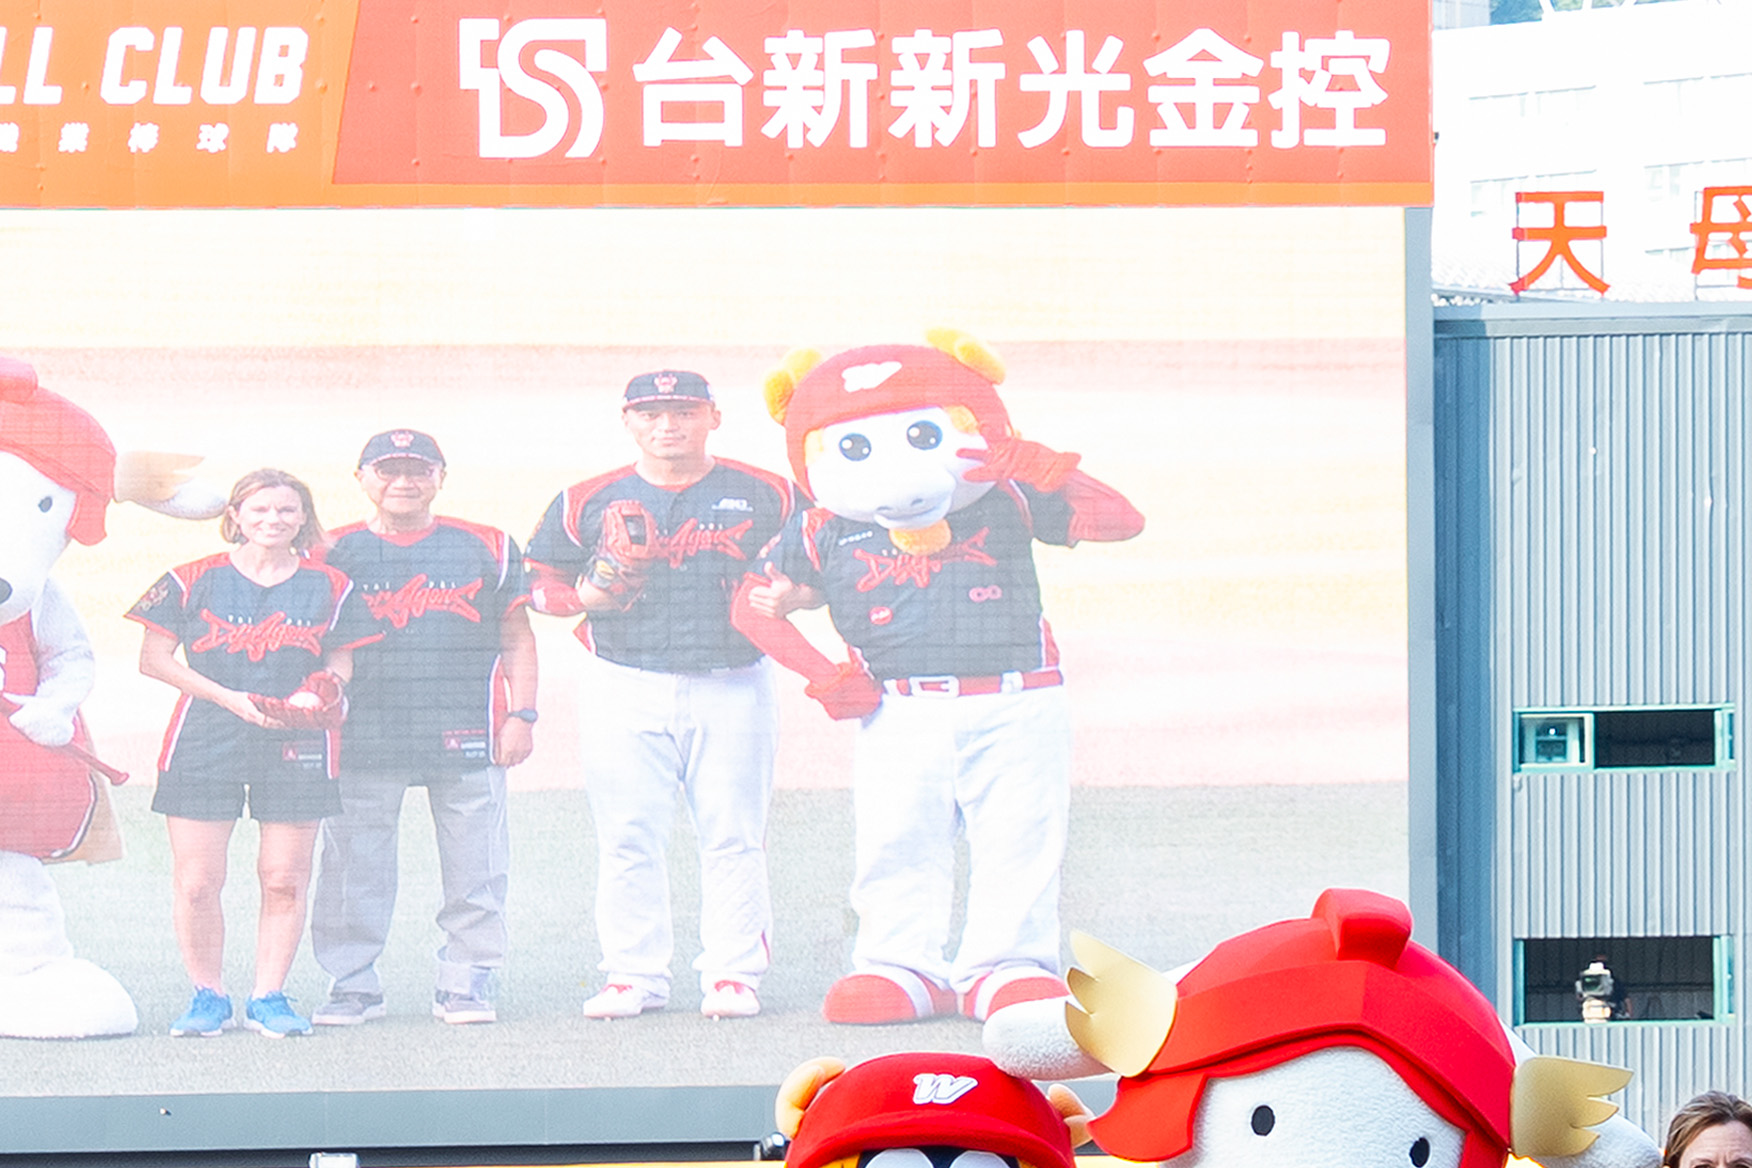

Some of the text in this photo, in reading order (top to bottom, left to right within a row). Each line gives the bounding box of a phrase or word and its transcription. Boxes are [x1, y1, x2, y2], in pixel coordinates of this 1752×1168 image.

[100, 26, 308, 105] CLUB
[632, 27, 1391, 149] 台新新光金控
[913, 1073, 978, 1105] W
